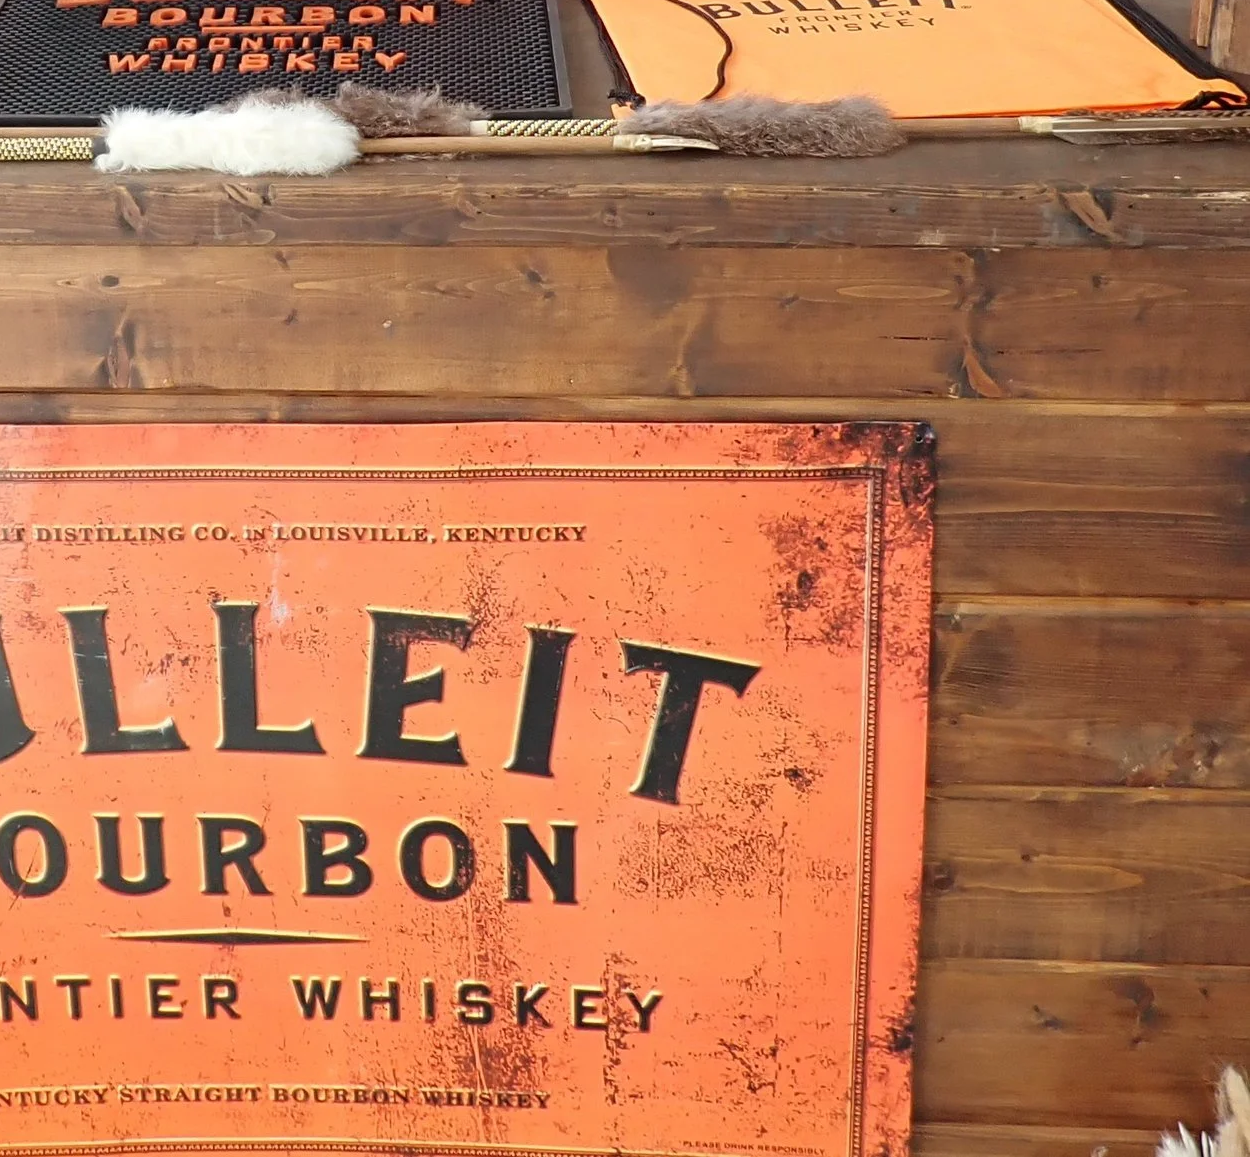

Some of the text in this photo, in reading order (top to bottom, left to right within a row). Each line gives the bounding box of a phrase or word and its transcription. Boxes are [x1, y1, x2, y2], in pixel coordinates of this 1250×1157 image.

[102, 4, 436, 28] BOURBON
[779, 10, 914, 24] FRONTIER
[768, 17, 936, 35] WHISKEY
[147, 35, 374, 52] FRONTIER
[108, 51, 407, 74] WHISKEY
[34, 524, 186, 542] DISTILLING
[446, 525, 587, 543] KENTUCKY
[290, 975, 664, 1034] WHISKEY
[117, 1085, 262, 1104] STRAIGHT
[270, 1085, 410, 1105] BOURBON
[420, 1087, 551, 1110] WHISKEY
[683, 1140, 826, 1156] PLEASE DRINK RESPONSIBLY
